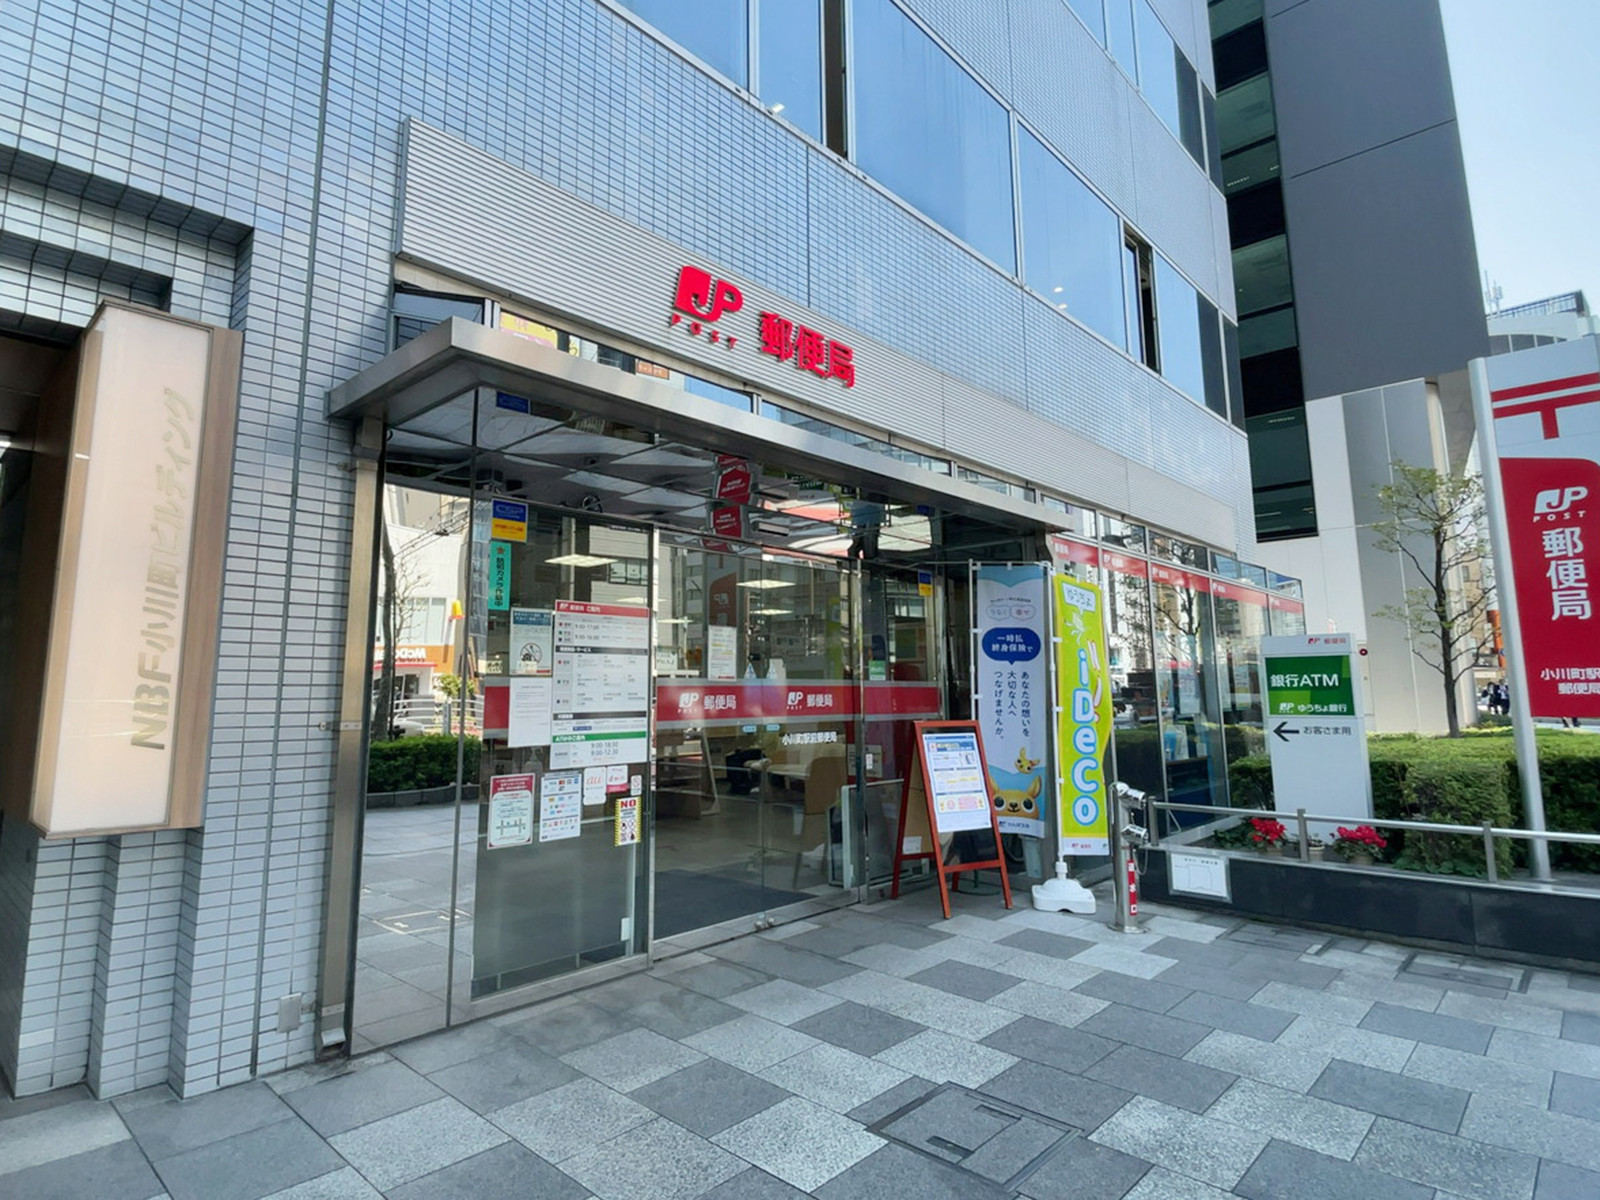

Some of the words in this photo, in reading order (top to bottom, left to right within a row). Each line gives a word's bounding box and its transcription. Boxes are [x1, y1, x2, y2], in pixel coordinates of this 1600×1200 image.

[669, 313, 738, 350] POST
[674, 266, 743, 322] JP
[760, 311, 855, 388] 郵便局
[1534, 486, 1588, 514] JP
[1533, 510, 1586, 523] POST
[130, 387, 194, 750] NBF小川町ビルディング
[1542, 527, 1592, 621] 郵便局
[1067, 588, 1093, 607] ゆうちょ
[992, 643, 1034, 653] 終身保険で
[997, 634, 1024, 643] 一時払
[1270, 673, 1339, 687] 銀行ATM
[704, 695, 736, 710] 郵便局
[806, 694, 833, 707] 郵便局
[1007, 671, 1017, 717] 大切な人へ
[994, 671, 1004, 739] つなげませんか。
[1021, 671, 1030, 737] あなたの想いを
[1298, 703, 1347, 712] ゆうちょ銀行
[1071, 647, 1099, 827] iDeCo
[1303, 726, 1351, 735] お客さま用
[620, 800, 637, 809] NO
